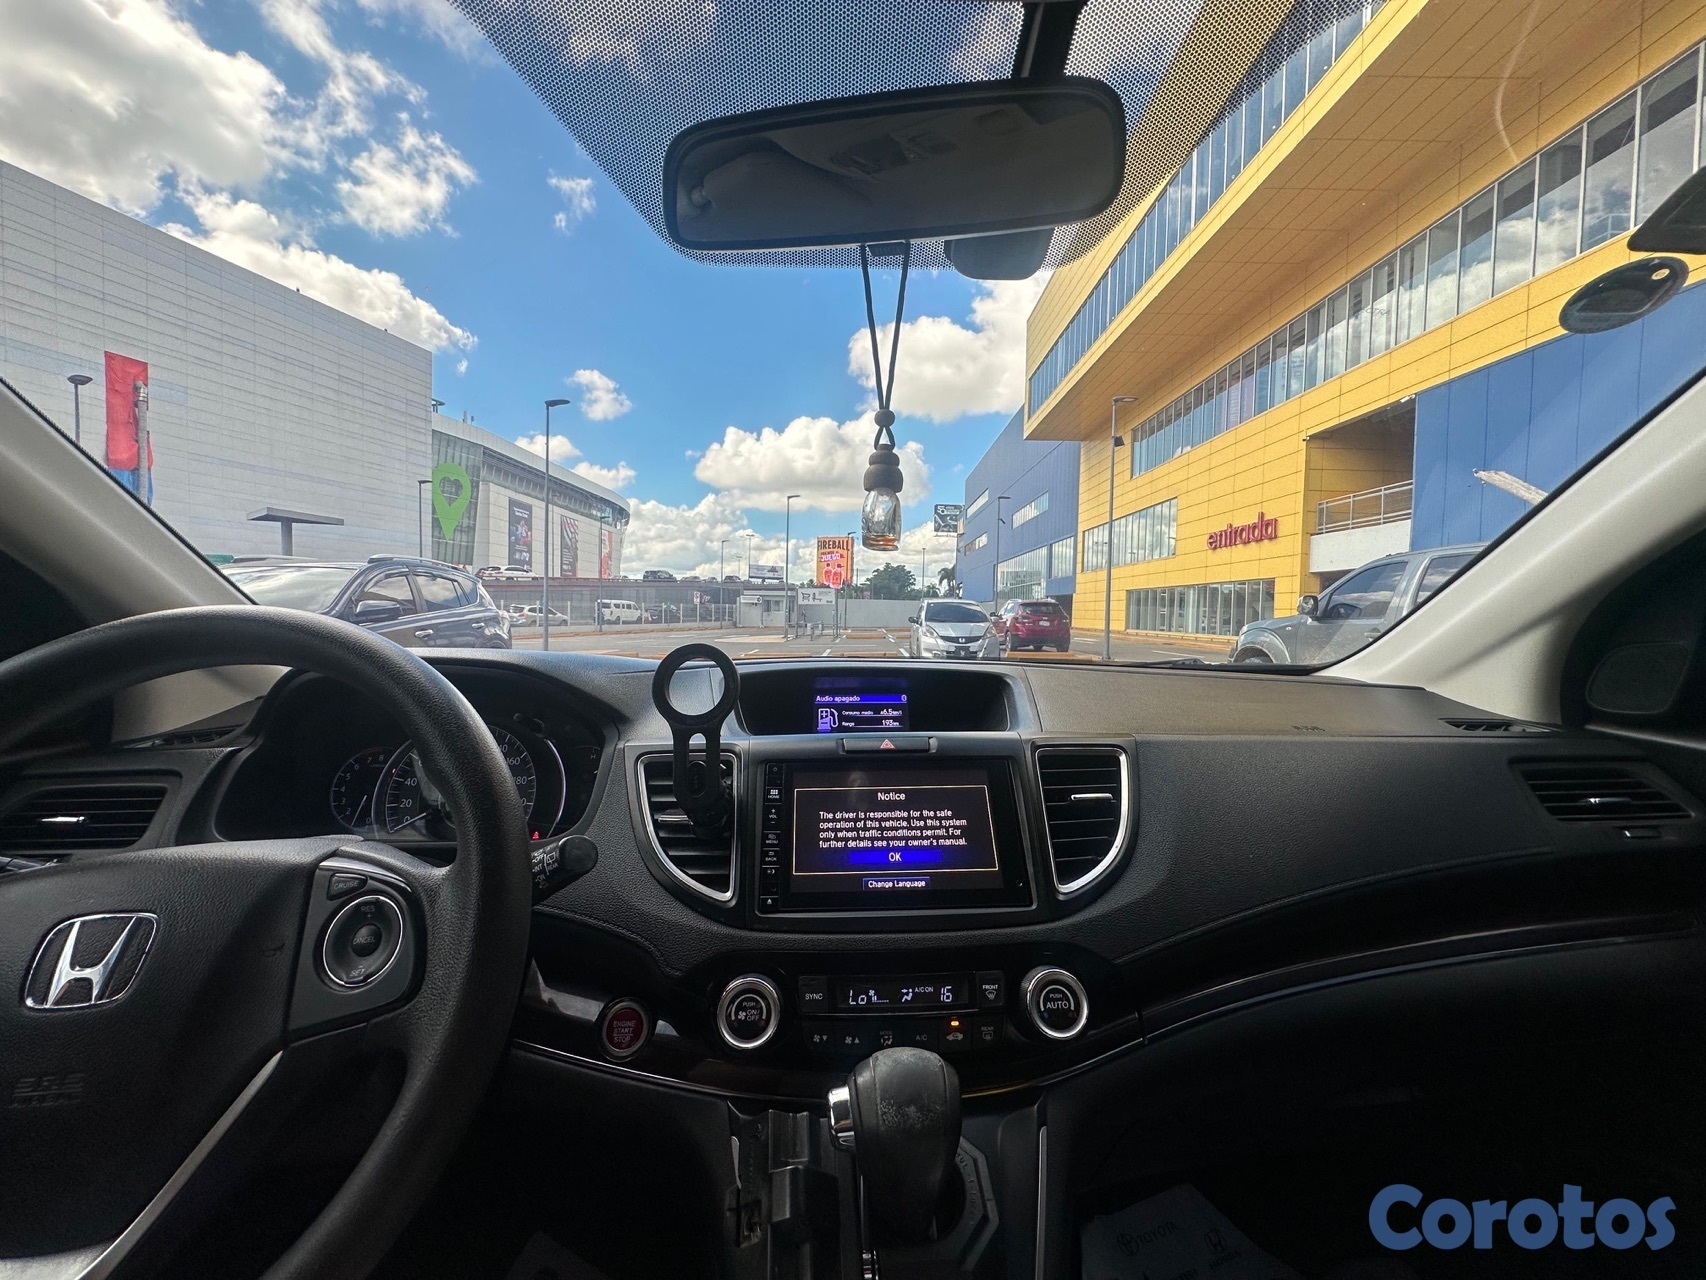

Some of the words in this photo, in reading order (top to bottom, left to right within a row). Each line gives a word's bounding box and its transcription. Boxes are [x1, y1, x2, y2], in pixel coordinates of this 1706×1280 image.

[1206, 511, 1278, 551] entrada
[817, 539, 850, 551] FIREBALL
[834, 695, 861, 703] apagado
[404, 778, 418, 787] 40
[877, 792, 906, 801] Notice
[399, 799, 413, 808] 20
[819, 811, 834, 820] The
[835, 811, 857, 819] driver
[858, 811, 865, 819] is
[866, 810, 908, 820] responsible
[910, 810, 921, 818] for
[922, 809, 935, 817] the
[936, 809, 952, 817] safe
[819, 820, 855, 830] operation
[856, 820, 865, 828] of
[866, 820, 880, 828] this
[881, 819, 909, 828] vehicle.
[910, 819, 924, 827] Use
[926, 818, 940, 827] this
[941, 819, 967, 829] system
[819, 830, 835, 840] only
[836, 830, 858, 838] when
[859, 829, 882, 838] traffic
[883, 828, 921, 838] conditions
[922, 828, 948, 838] permit.
[949, 828, 961, 836] For
[819, 840, 845, 848] further
[847, 839, 872, 848] details
[889, 840, 906, 849] your
[907, 838, 937, 847] owner's
[938, 837, 968, 846] manual.
[888, 852, 902, 862] OK
[333, 880, 359, 890] CRUISE
[868, 880, 893, 889] Change
[894, 880, 926, 889] Language
[360, 904, 376, 913] RES
[353, 937, 376, 945] CANCEL
[349, 968, 366, 978] SET
[940, 986, 953, 1002] 16
[1046, 1000, 1069, 1009] AUTO
[613, 1020, 637, 1028] ENGINE
[613, 1035, 631, 1044] STOP
[1137, 1220, 1180, 1245] TOYOTA
